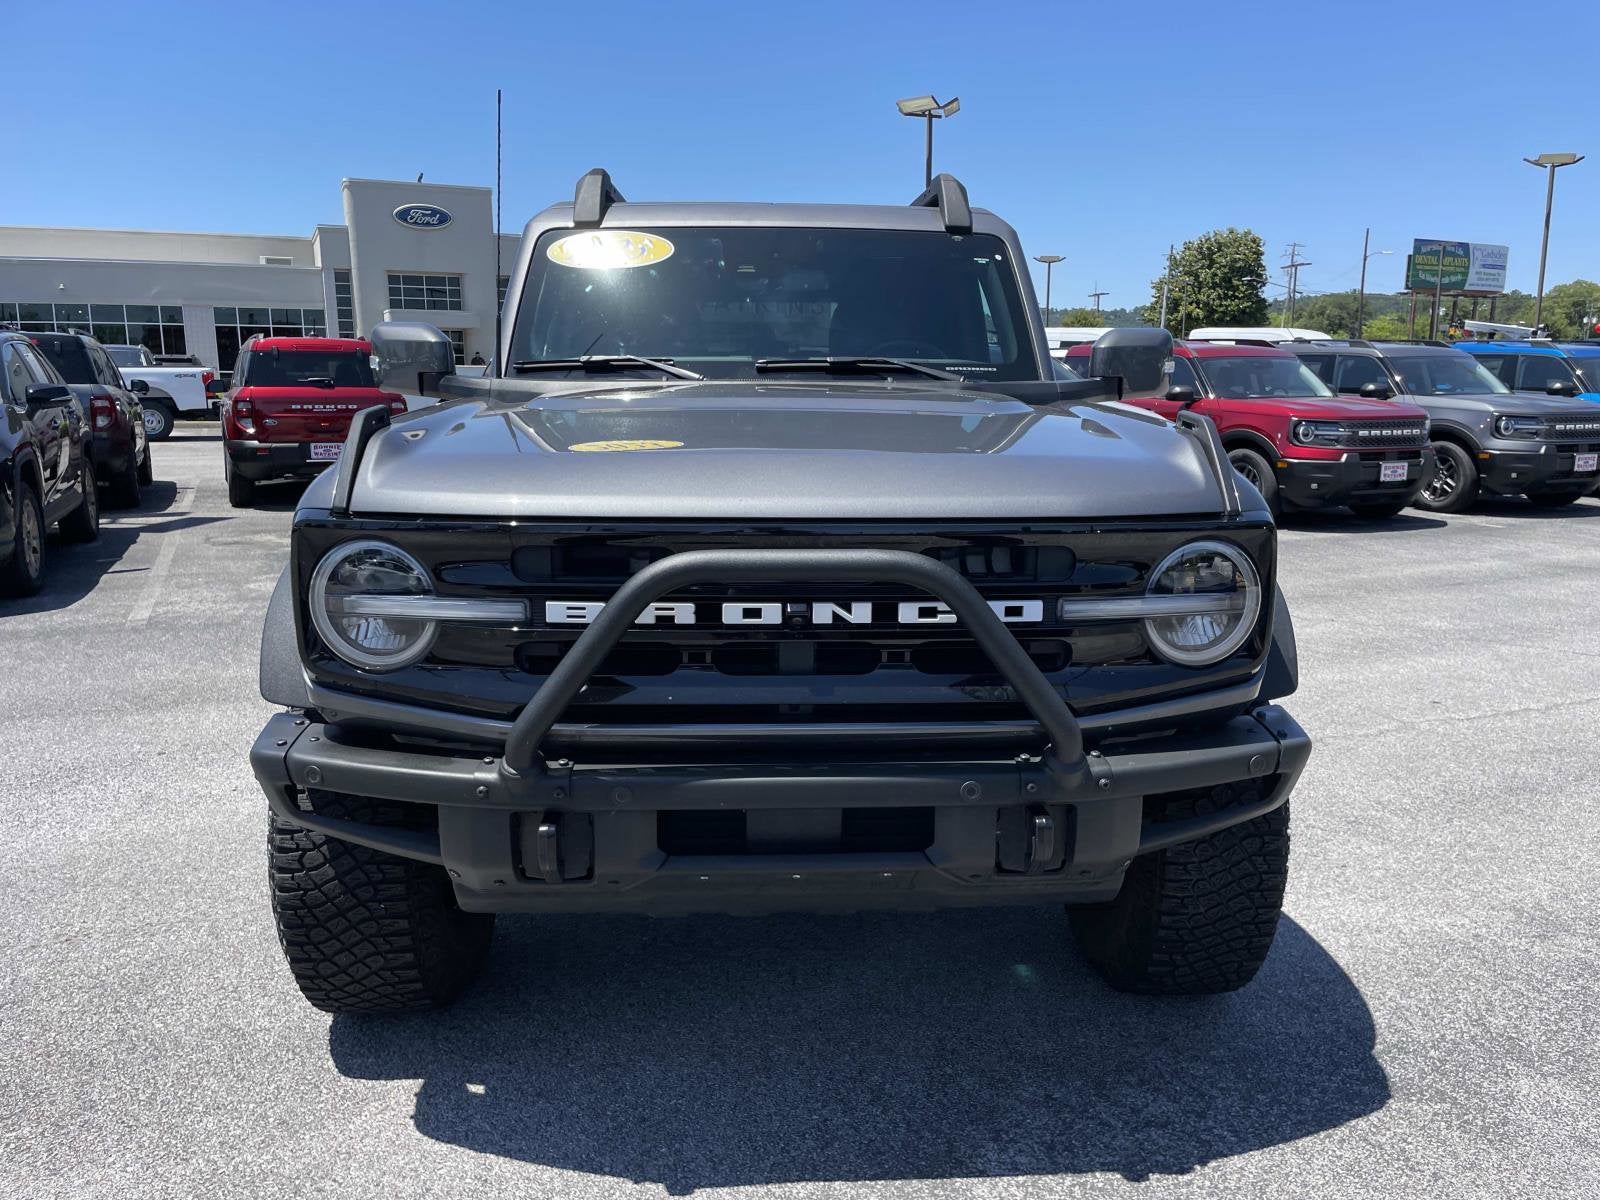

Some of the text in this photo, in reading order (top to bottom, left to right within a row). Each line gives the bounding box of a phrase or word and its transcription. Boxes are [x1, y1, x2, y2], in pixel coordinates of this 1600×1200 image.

[407, 209, 440, 224] Ford
[1415, 255, 1438, 265] DENTAL
[1358, 429, 1421, 437] BRONCO
[545, 600, 1044, 626] BRONCO
